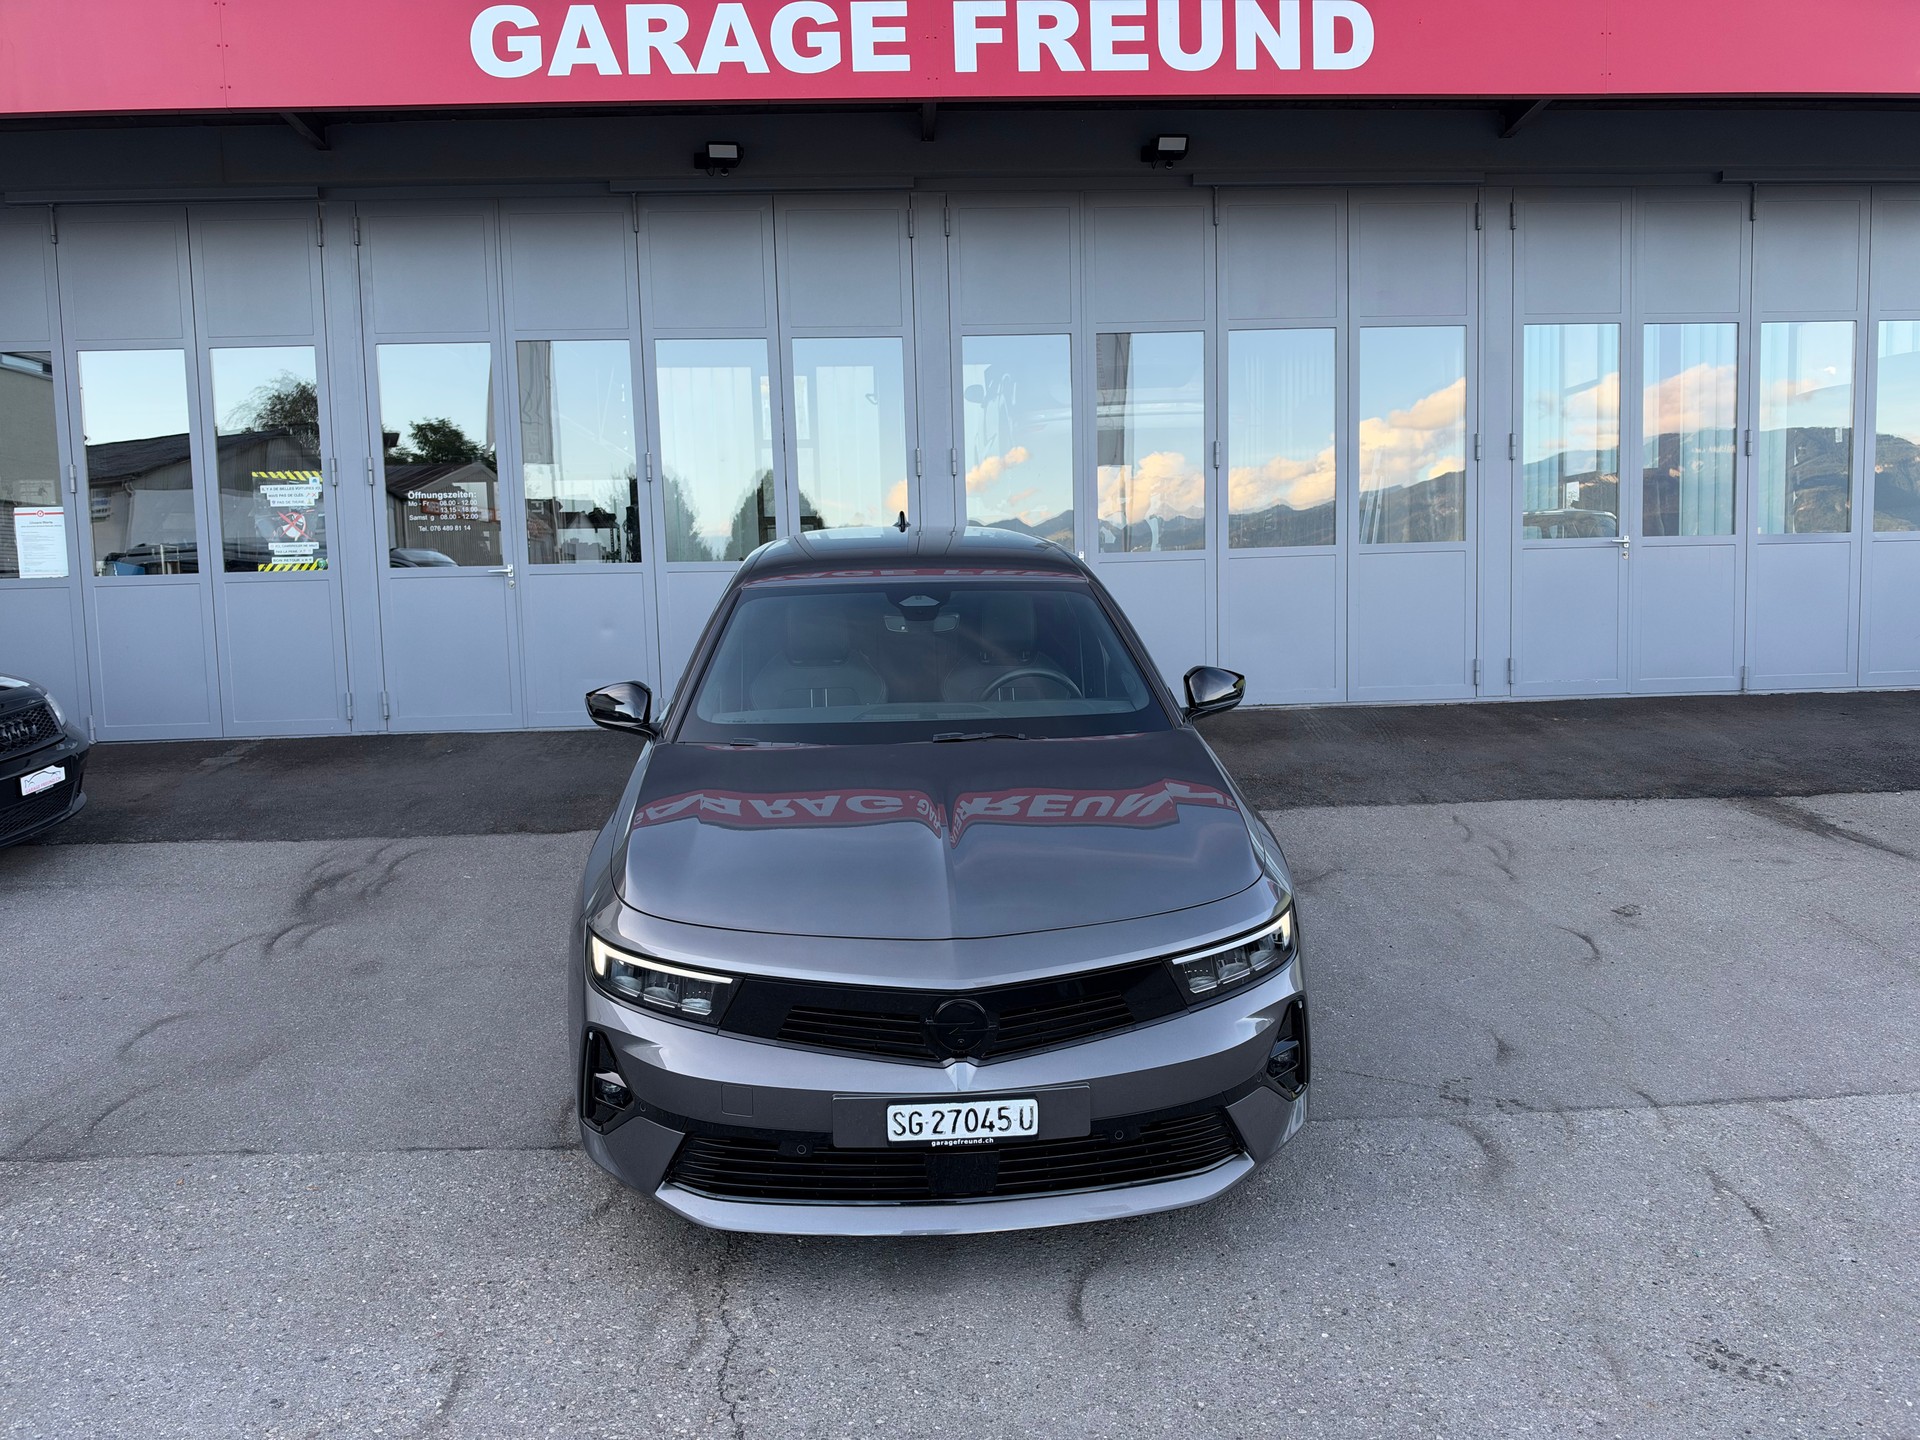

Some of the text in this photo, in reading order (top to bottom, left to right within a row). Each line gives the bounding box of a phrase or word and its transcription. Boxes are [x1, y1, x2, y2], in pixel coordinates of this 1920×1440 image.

[469, 0, 1374, 78] GARAGE FREUND
[408, 491, 476, 500] Öffnungszeiten:
[892, 1106, 1034, 1136] SG 27045 U
[931, 1137, 994, 1147] garagefreund.ch
